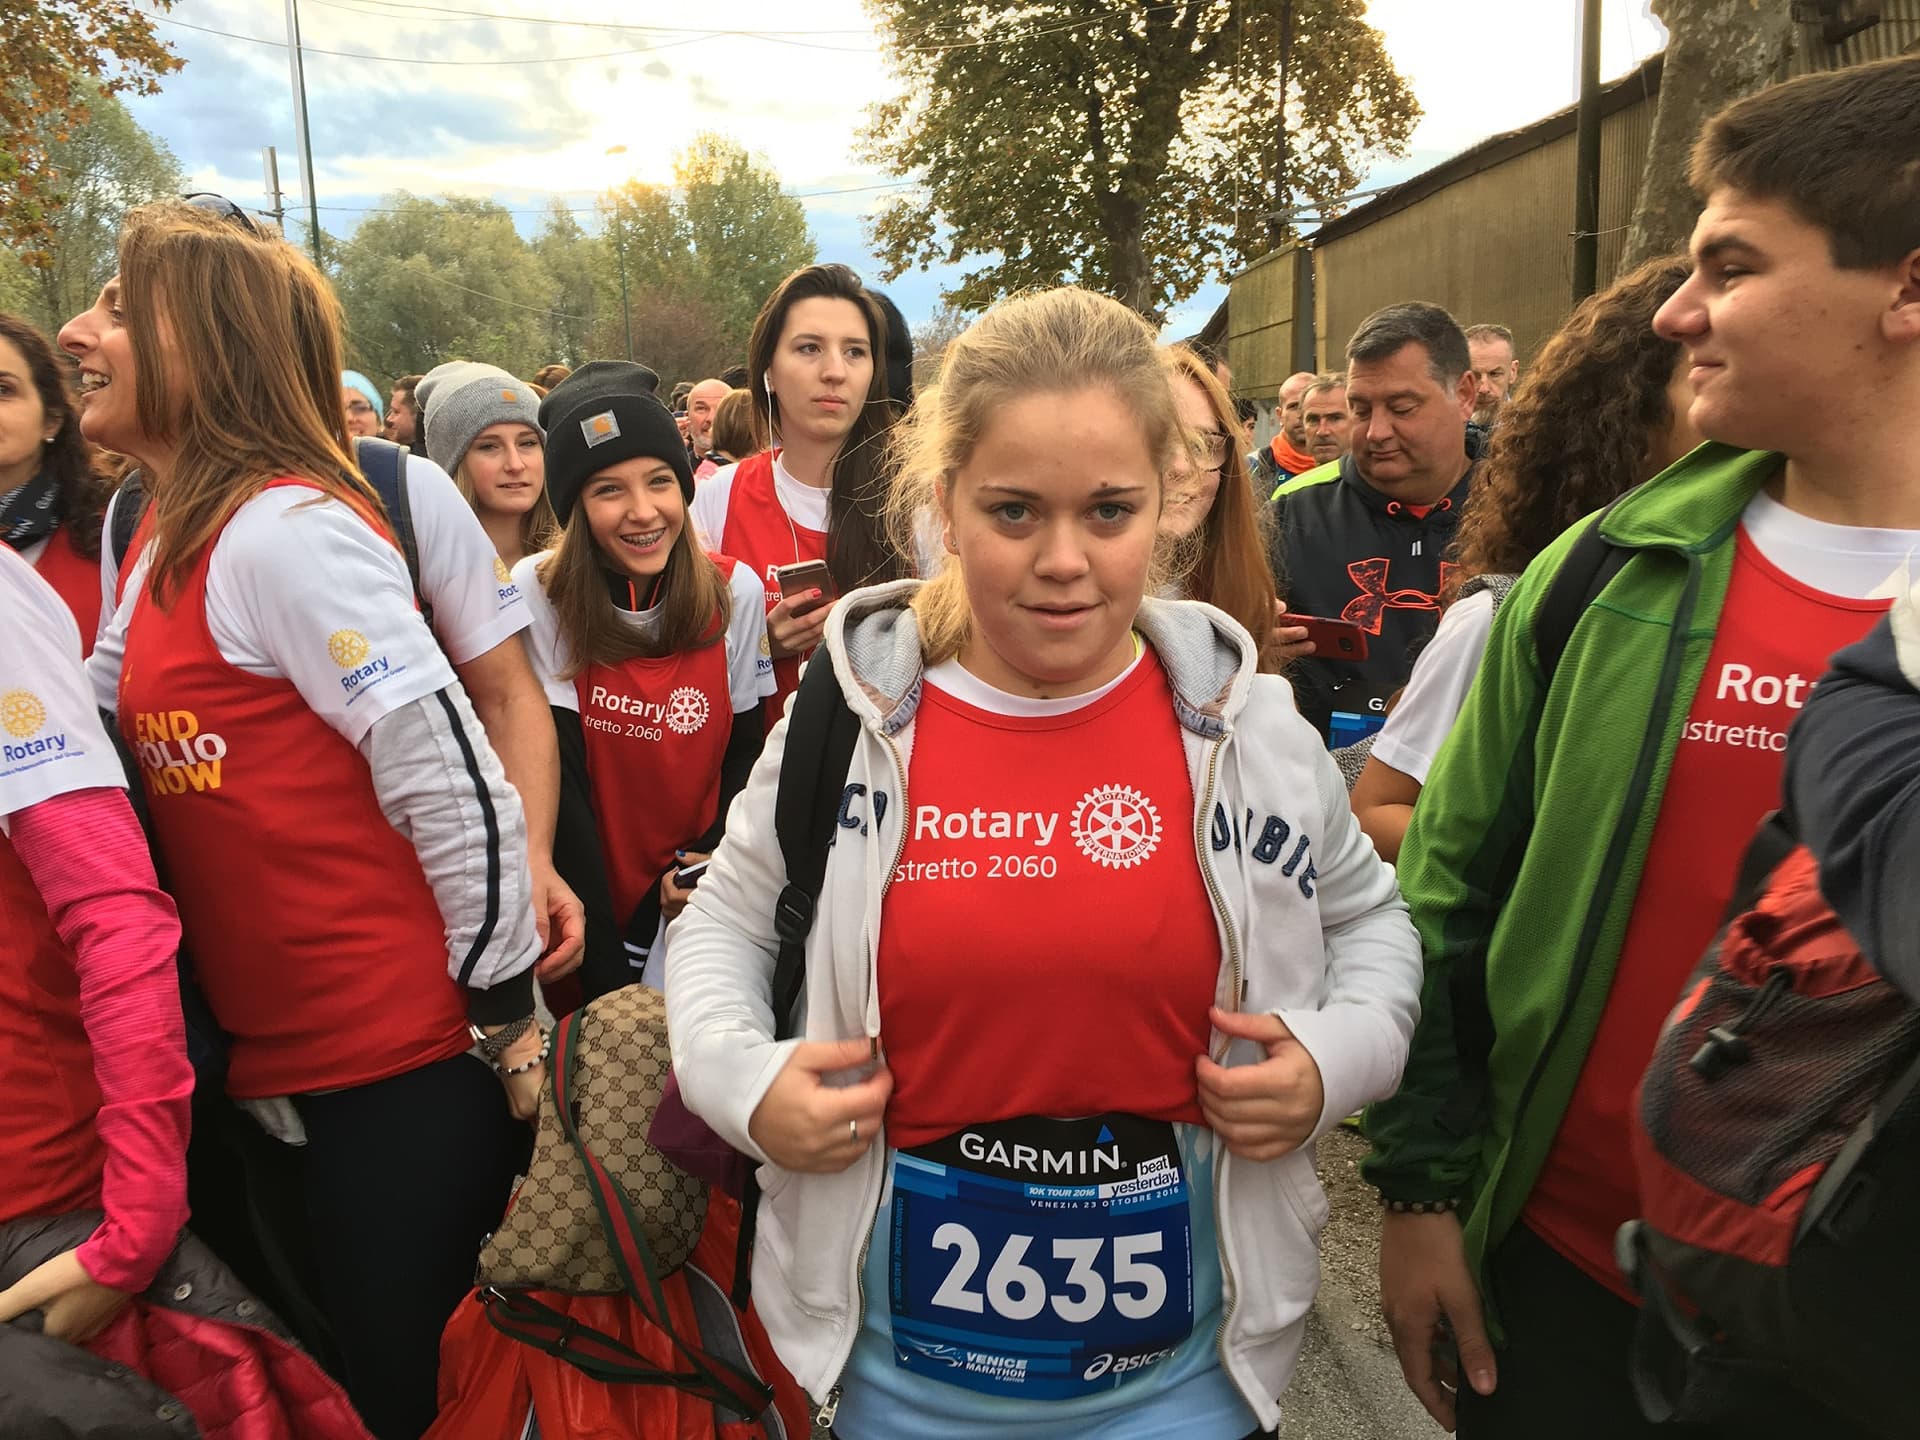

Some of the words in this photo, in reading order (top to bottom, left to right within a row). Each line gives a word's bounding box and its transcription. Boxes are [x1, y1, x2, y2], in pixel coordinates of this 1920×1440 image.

[341, 656, 389, 693] Rotary
[1716, 663, 1817, 709] Rot
[591, 685, 667, 724] Rotary
[136, 710, 199, 743] END
[625, 724, 663, 742] 2060
[3, 733, 65, 762] Rotary
[146, 760, 221, 796] NOW
[1098, 792, 1136, 804] ROTARY
[914, 805, 1059, 846] Rotary
[1084, 837, 1151, 861] INTERNATIONAL
[895, 857, 978, 882] stretto
[987, 855, 1057, 878] 2060
[960, 1132, 1120, 1175] GARMIN
[1140, 1156, 1168, 1176] beat
[1029, 1187, 1045, 1196] 10K
[1047, 1187, 1072, 1197] TOUR
[1073, 1187, 1096, 1197] 2016
[1111, 1170, 1179, 1197] yesterday.
[1030, 1200, 1079, 1209] VENEZIA
[1083, 1201, 1097, 1209] 23
[1102, 1193, 1152, 1208] OTTOBRE
[1156, 1187, 1180, 1199] 2016
[931, 1222, 1167, 1323] 2635
[965, 1362, 1026, 1378] MARATHON
[966, 1352, 1028, 1370] VENICE
